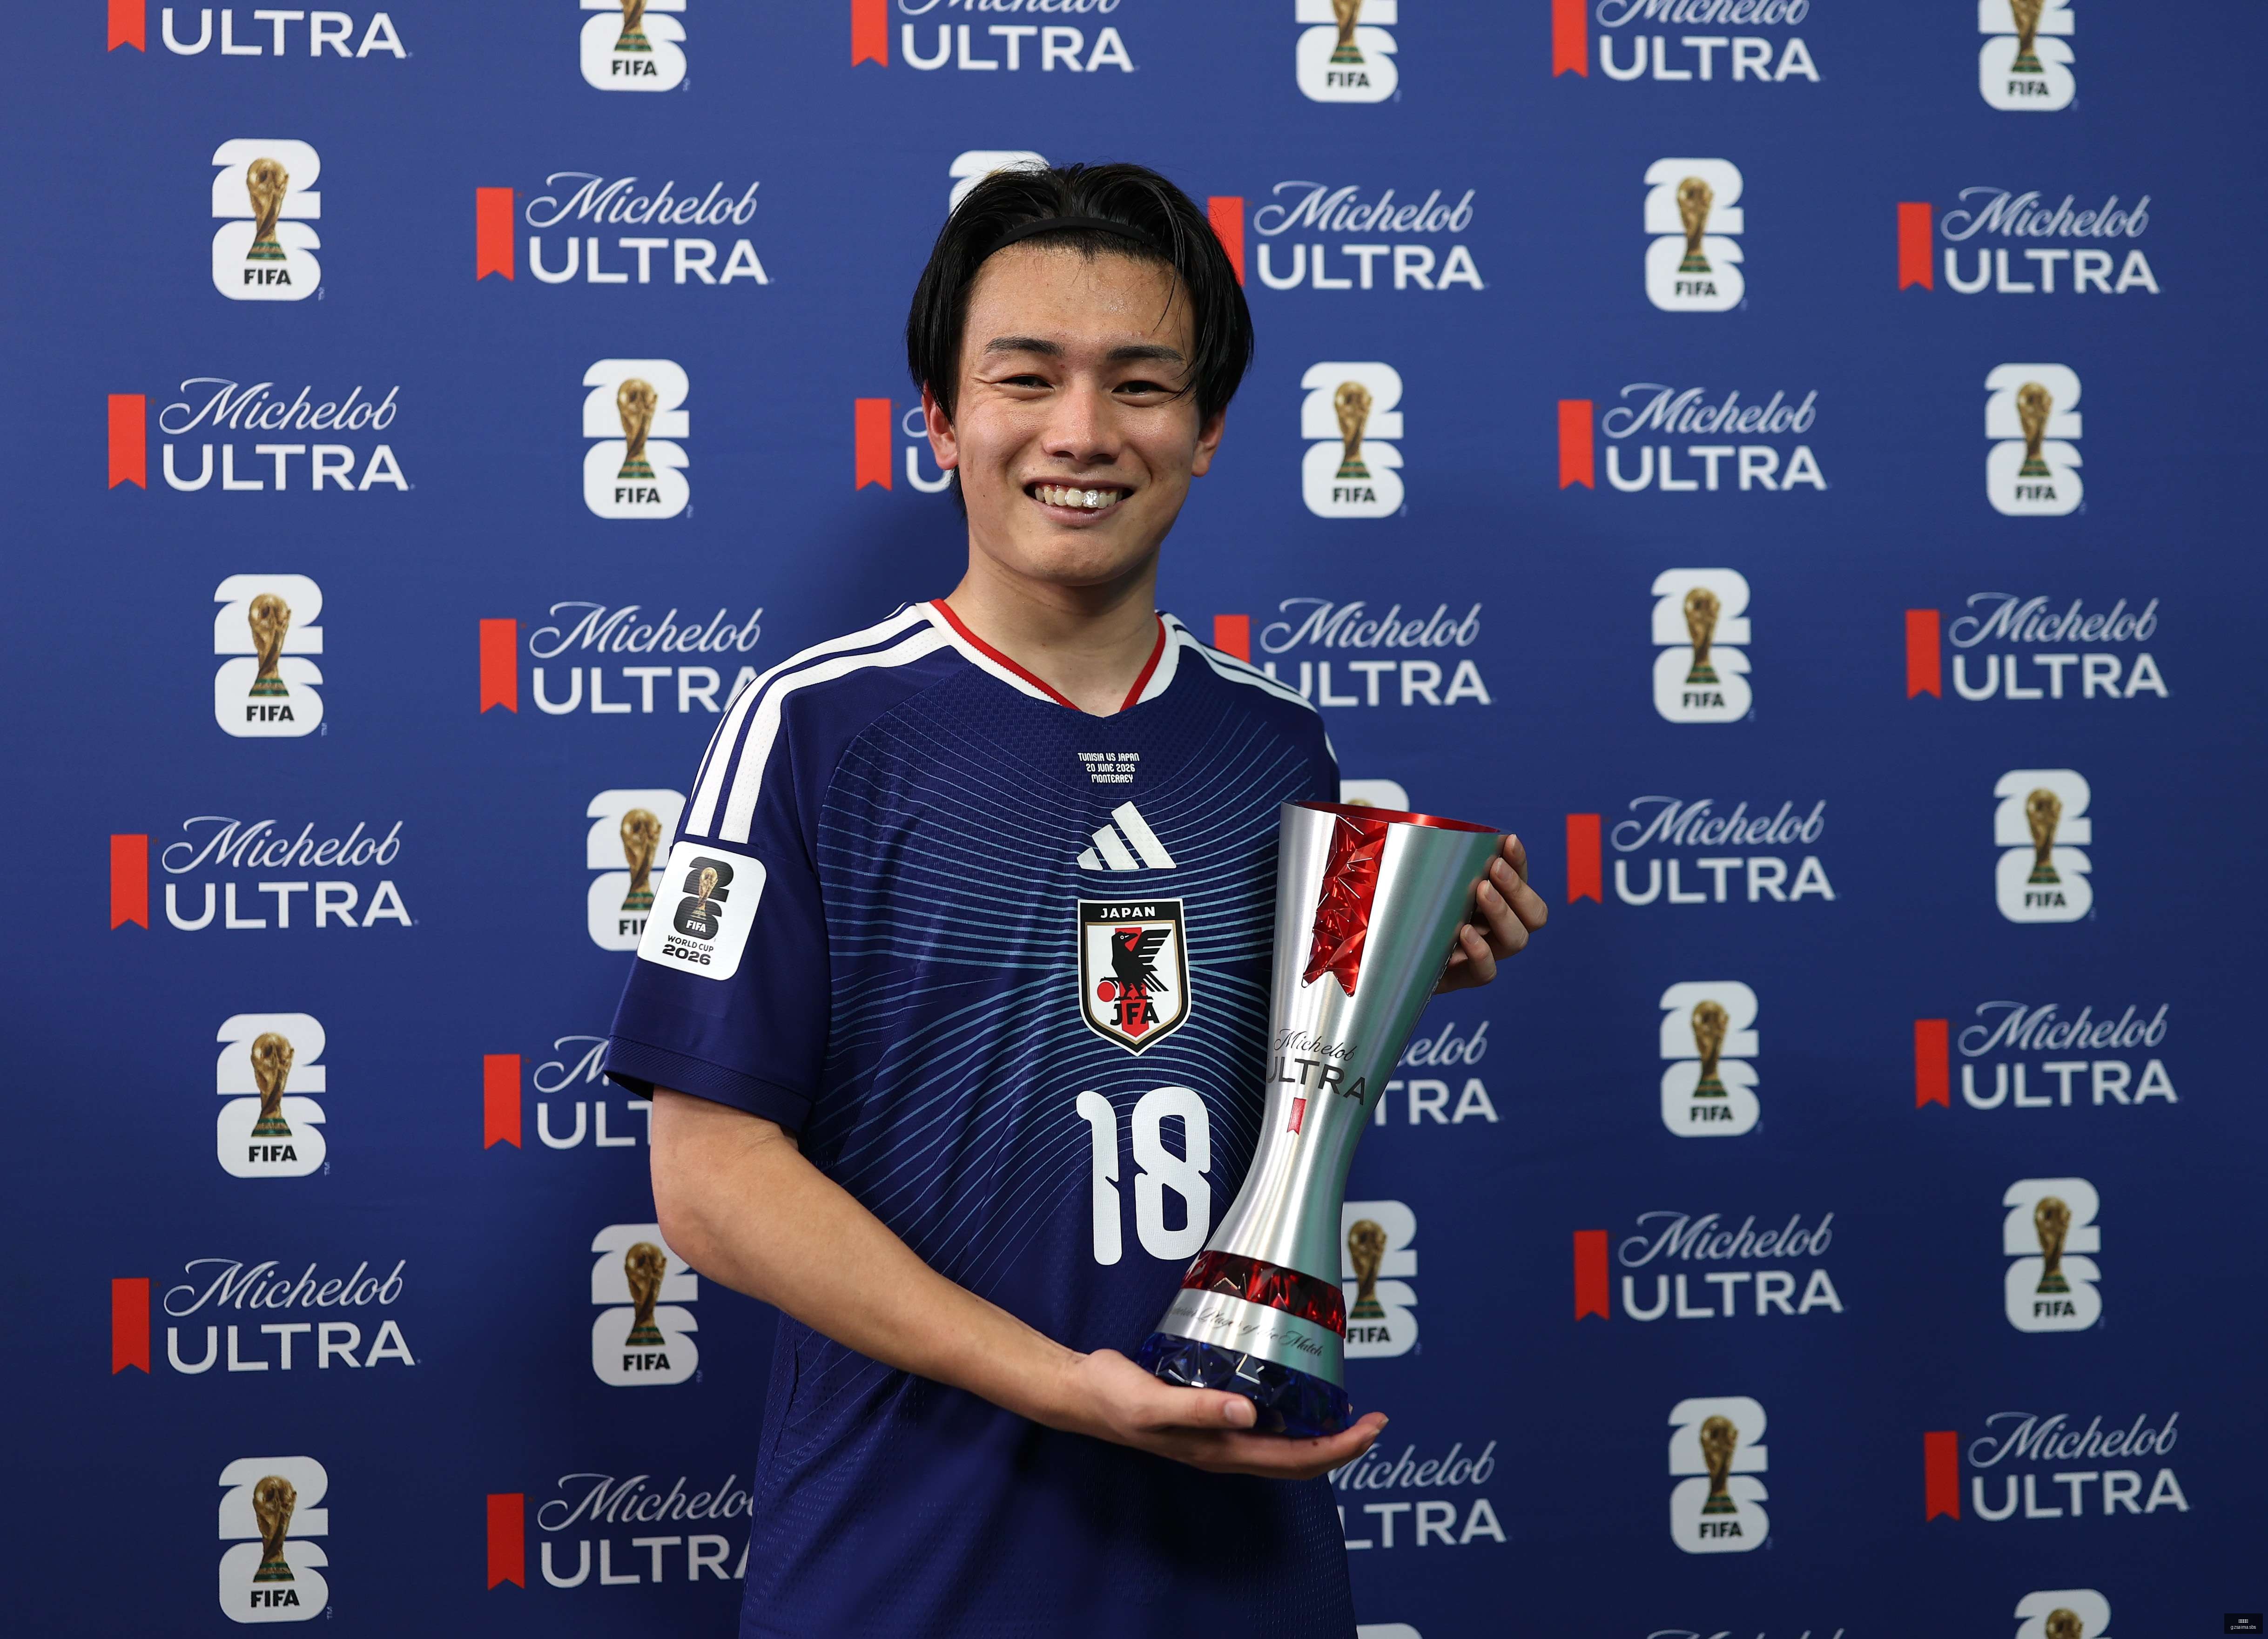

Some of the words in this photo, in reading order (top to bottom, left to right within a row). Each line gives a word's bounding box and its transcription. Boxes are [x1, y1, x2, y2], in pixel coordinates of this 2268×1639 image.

[162, 7, 407, 59] ULTRA
[902, 23, 1134, 72] ULTRA
[612, 60, 658, 76] FIFA
[1327, 71, 1370, 88] FIFA
[1600, 35, 1820, 82] ULTRA
[2008, 80, 2049, 96] FIFA
[525, 172, 759, 228] Michelob
[1254, 181, 1475, 236] Michelob
[1941, 187, 2151, 241] Michelob
[243, 269, 292, 285] FIFA
[529, 236, 769, 285] ULTRA
[1257, 243, 1484, 290] ULTRA
[1945, 248, 2159, 294] ULTRA
[1675, 281, 1717, 296] FIFA
[160, 378, 399, 434] Michelob
[1602, 383, 1817, 438] Michelob
[163, 444, 409, 492] ULTRA
[1606, 445, 1827, 492] ULTRA
[615, 487, 661, 504] FIFA
[1333, 487, 1376, 503] FIFA
[2015, 485, 2057, 500] FIFA
[529, 602, 763, 658] Michelob
[1260, 598, 1481, 654] Michelob
[1949, 592, 2159, 648] Michelob
[1682, 692, 1725, 707] FIFA
[1953, 653, 2168, 701] ULTRA
[246, 705, 295, 722] FIFA
[1077, 752, 1104, 762] TUNISIA
[1117, 753, 1140, 762] JAPAN
[1086, 763, 1096, 772] 20
[1097, 763, 1115, 773] JUNE
[1117, 763, 1136, 773] 2026
[1091, 774, 1133, 783] MONTERREY
[162, 816, 403, 874] Michelob
[1611, 796, 1826, 852] Michelob
[1615, 856, 1835, 905] ULTRA
[2025, 891, 2066, 907] FIFA
[166, 880, 412, 931] ULTRA
[686, 919, 707, 933] FIFA
[1100, 906, 1156, 918] JAPAN
[662, 944, 712, 965] 2026
[667, 935, 698, 949] WORLD
[698, 943, 714, 952] CUP
[1110, 1002, 1160, 1026] JFA
[1958, 1001, 2169, 1057] Michelob
[1274, 1028, 1357, 1061] Michelob
[1398, 1021, 1489, 1066] elob
[1374, 1078, 1499, 1126] TRA
[1962, 1059, 2178, 1110] ULTRA
[1690, 1105, 1733, 1122] FIFA
[248, 1145, 298, 1163] FIFA
[1076, 1086, 1211, 1265] 18
[1618, 1211, 1834, 1268] Michelob
[164, 1259, 406, 1316] Michelob
[1622, 1269, 1844, 1321] ULTRA
[2033, 1301, 2076, 1317] FIFA
[167, 1320, 415, 1375] ULTRA
[1279, 1330, 1324, 1357] Match
[1346, 1326, 1391, 1344] FIFA
[623, 1353, 671, 1372] FIFA
[1968, 1412, 2179, 1468] Michelob
[1972, 1468, 2189, 1521] ULTRA
[1337, 1498, 1507, 1550] LTRA
[1699, 1521, 1743, 1539] FIFA
[250, 1589, 300, 1608] FIFA
